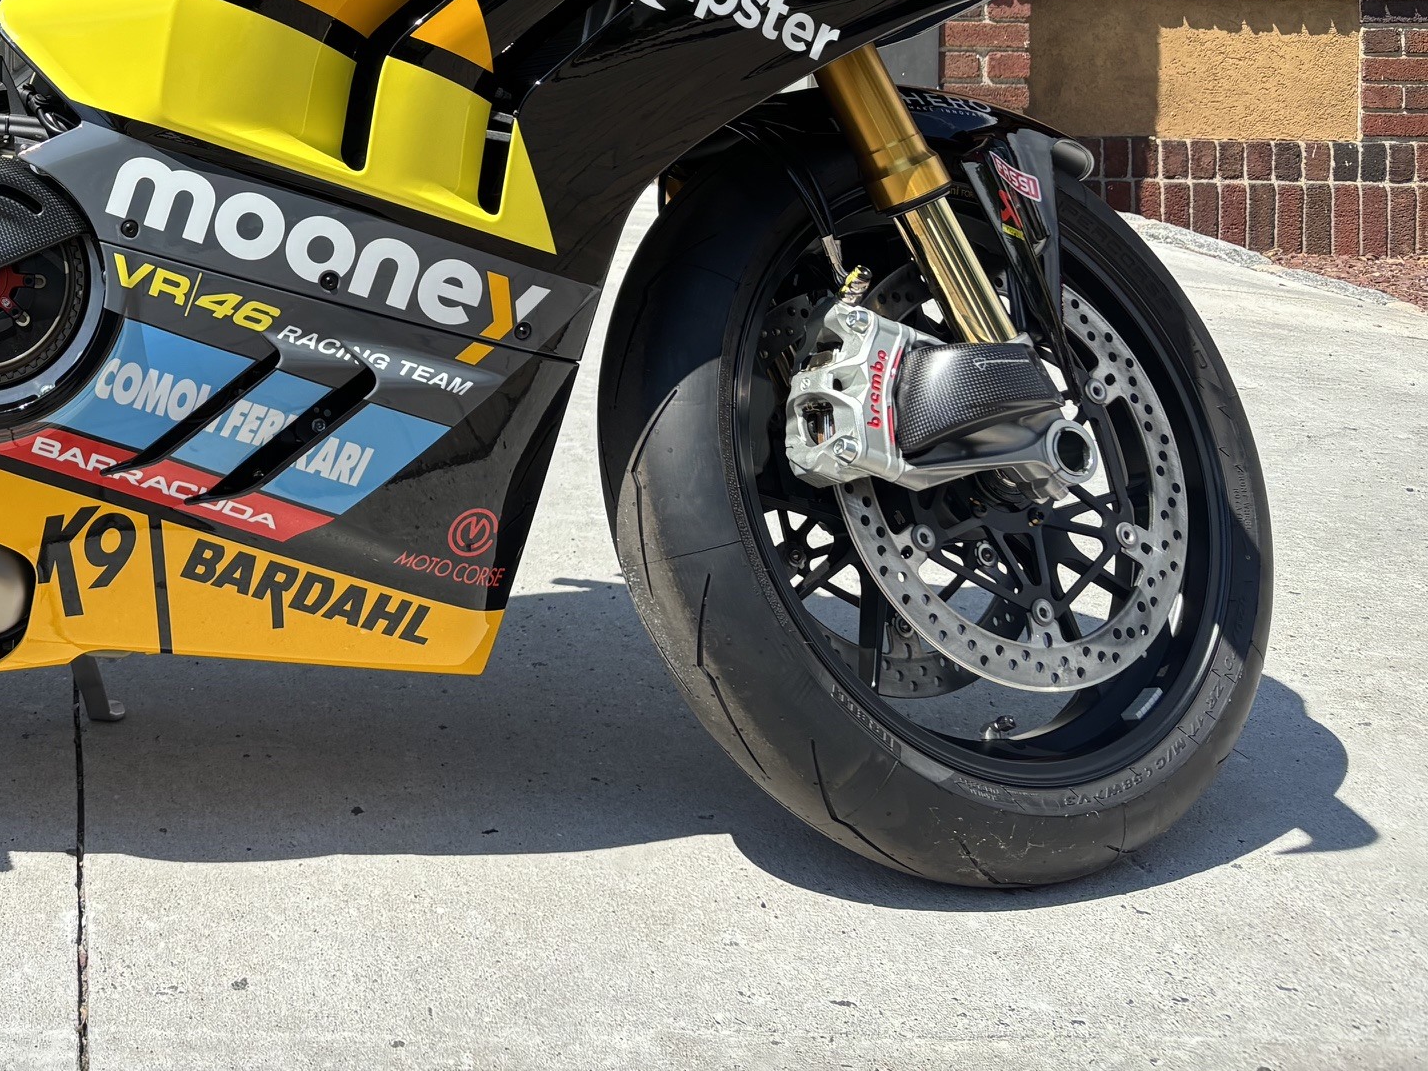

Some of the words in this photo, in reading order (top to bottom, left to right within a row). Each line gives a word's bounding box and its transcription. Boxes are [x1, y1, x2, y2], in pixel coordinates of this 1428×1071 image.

[105, 156, 551, 365] mooney
[276, 325, 389, 370] RACING
[398, 360, 474, 396] TEAM
[866, 350, 888, 429] brembo
[37, 505, 137, 617] K9
[179, 538, 433, 645] BARDAHL
[393, 550, 453, 577] MOTO
[452, 562, 506, 587] CORSE
